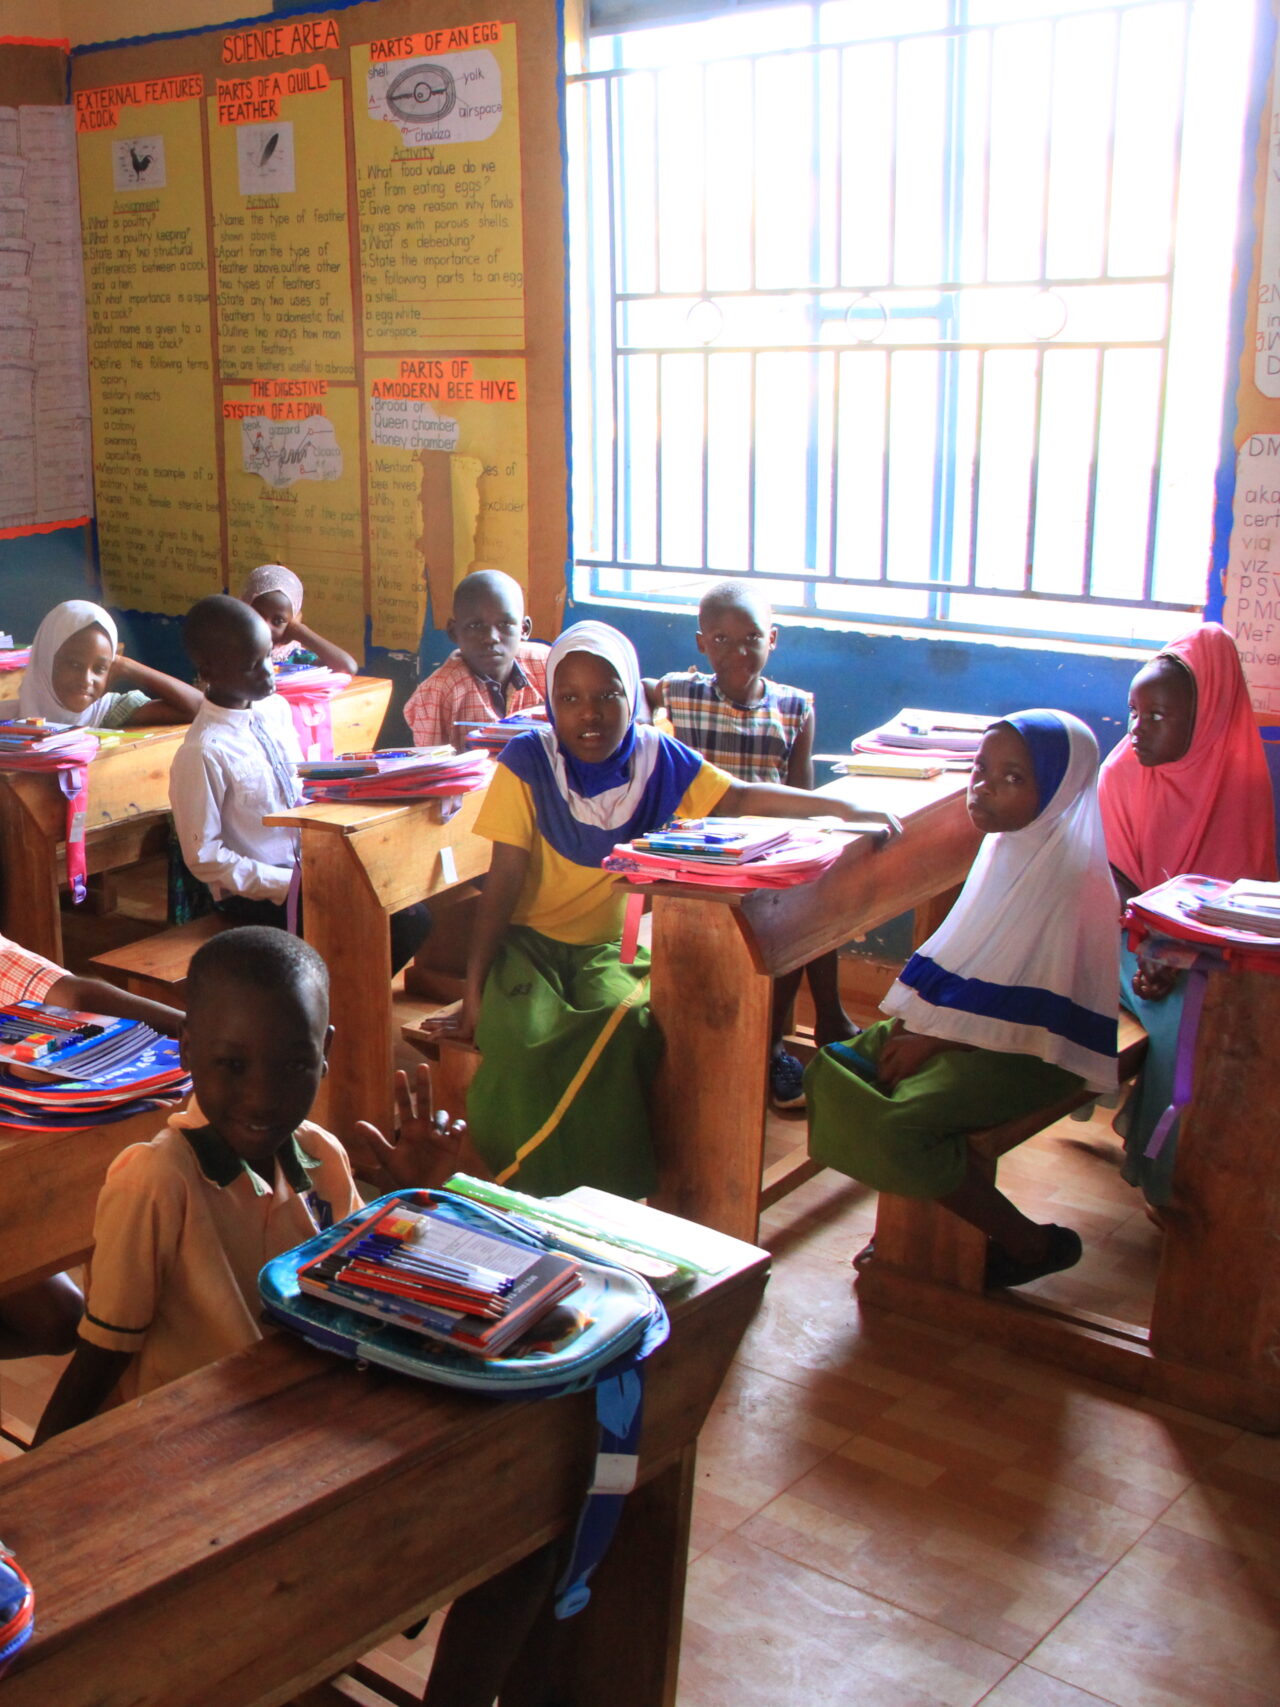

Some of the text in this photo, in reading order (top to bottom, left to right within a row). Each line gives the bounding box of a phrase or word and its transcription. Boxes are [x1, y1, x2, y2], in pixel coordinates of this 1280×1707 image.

[223, 20, 340, 64] SCIENCE AREA
[370, 23, 499, 60] PARTS OF AN EGG
[368, 63, 389, 79] shell
[463, 68, 485, 85] yolk
[76, 78, 203, 112] EXTERNAL FEATURES
[219, 70, 327, 102] PARTS QUILL
[219, 100, 278, 122] FEATHER
[459, 103, 503, 120] airspace
[368, 160, 496, 180] What food value do we
[360, 187, 376, 203] get
[384, 181, 406, 195] from
[413, 181, 445, 198] eating
[401, 360, 470, 379] PARTS OF
[252, 380, 327, 398] THE DIGESTIVE
[383, 381, 516, 400] MODERN BEE HIVE
[223, 402, 284, 419] SYSTEM OF
[375, 398, 424, 412] Brood or
[374, 412, 456, 433] Queen chamber
[375, 432, 456, 450] Honey chamber
[1241, 537, 1272, 551] via
[1240, 559, 1269, 574] viz
